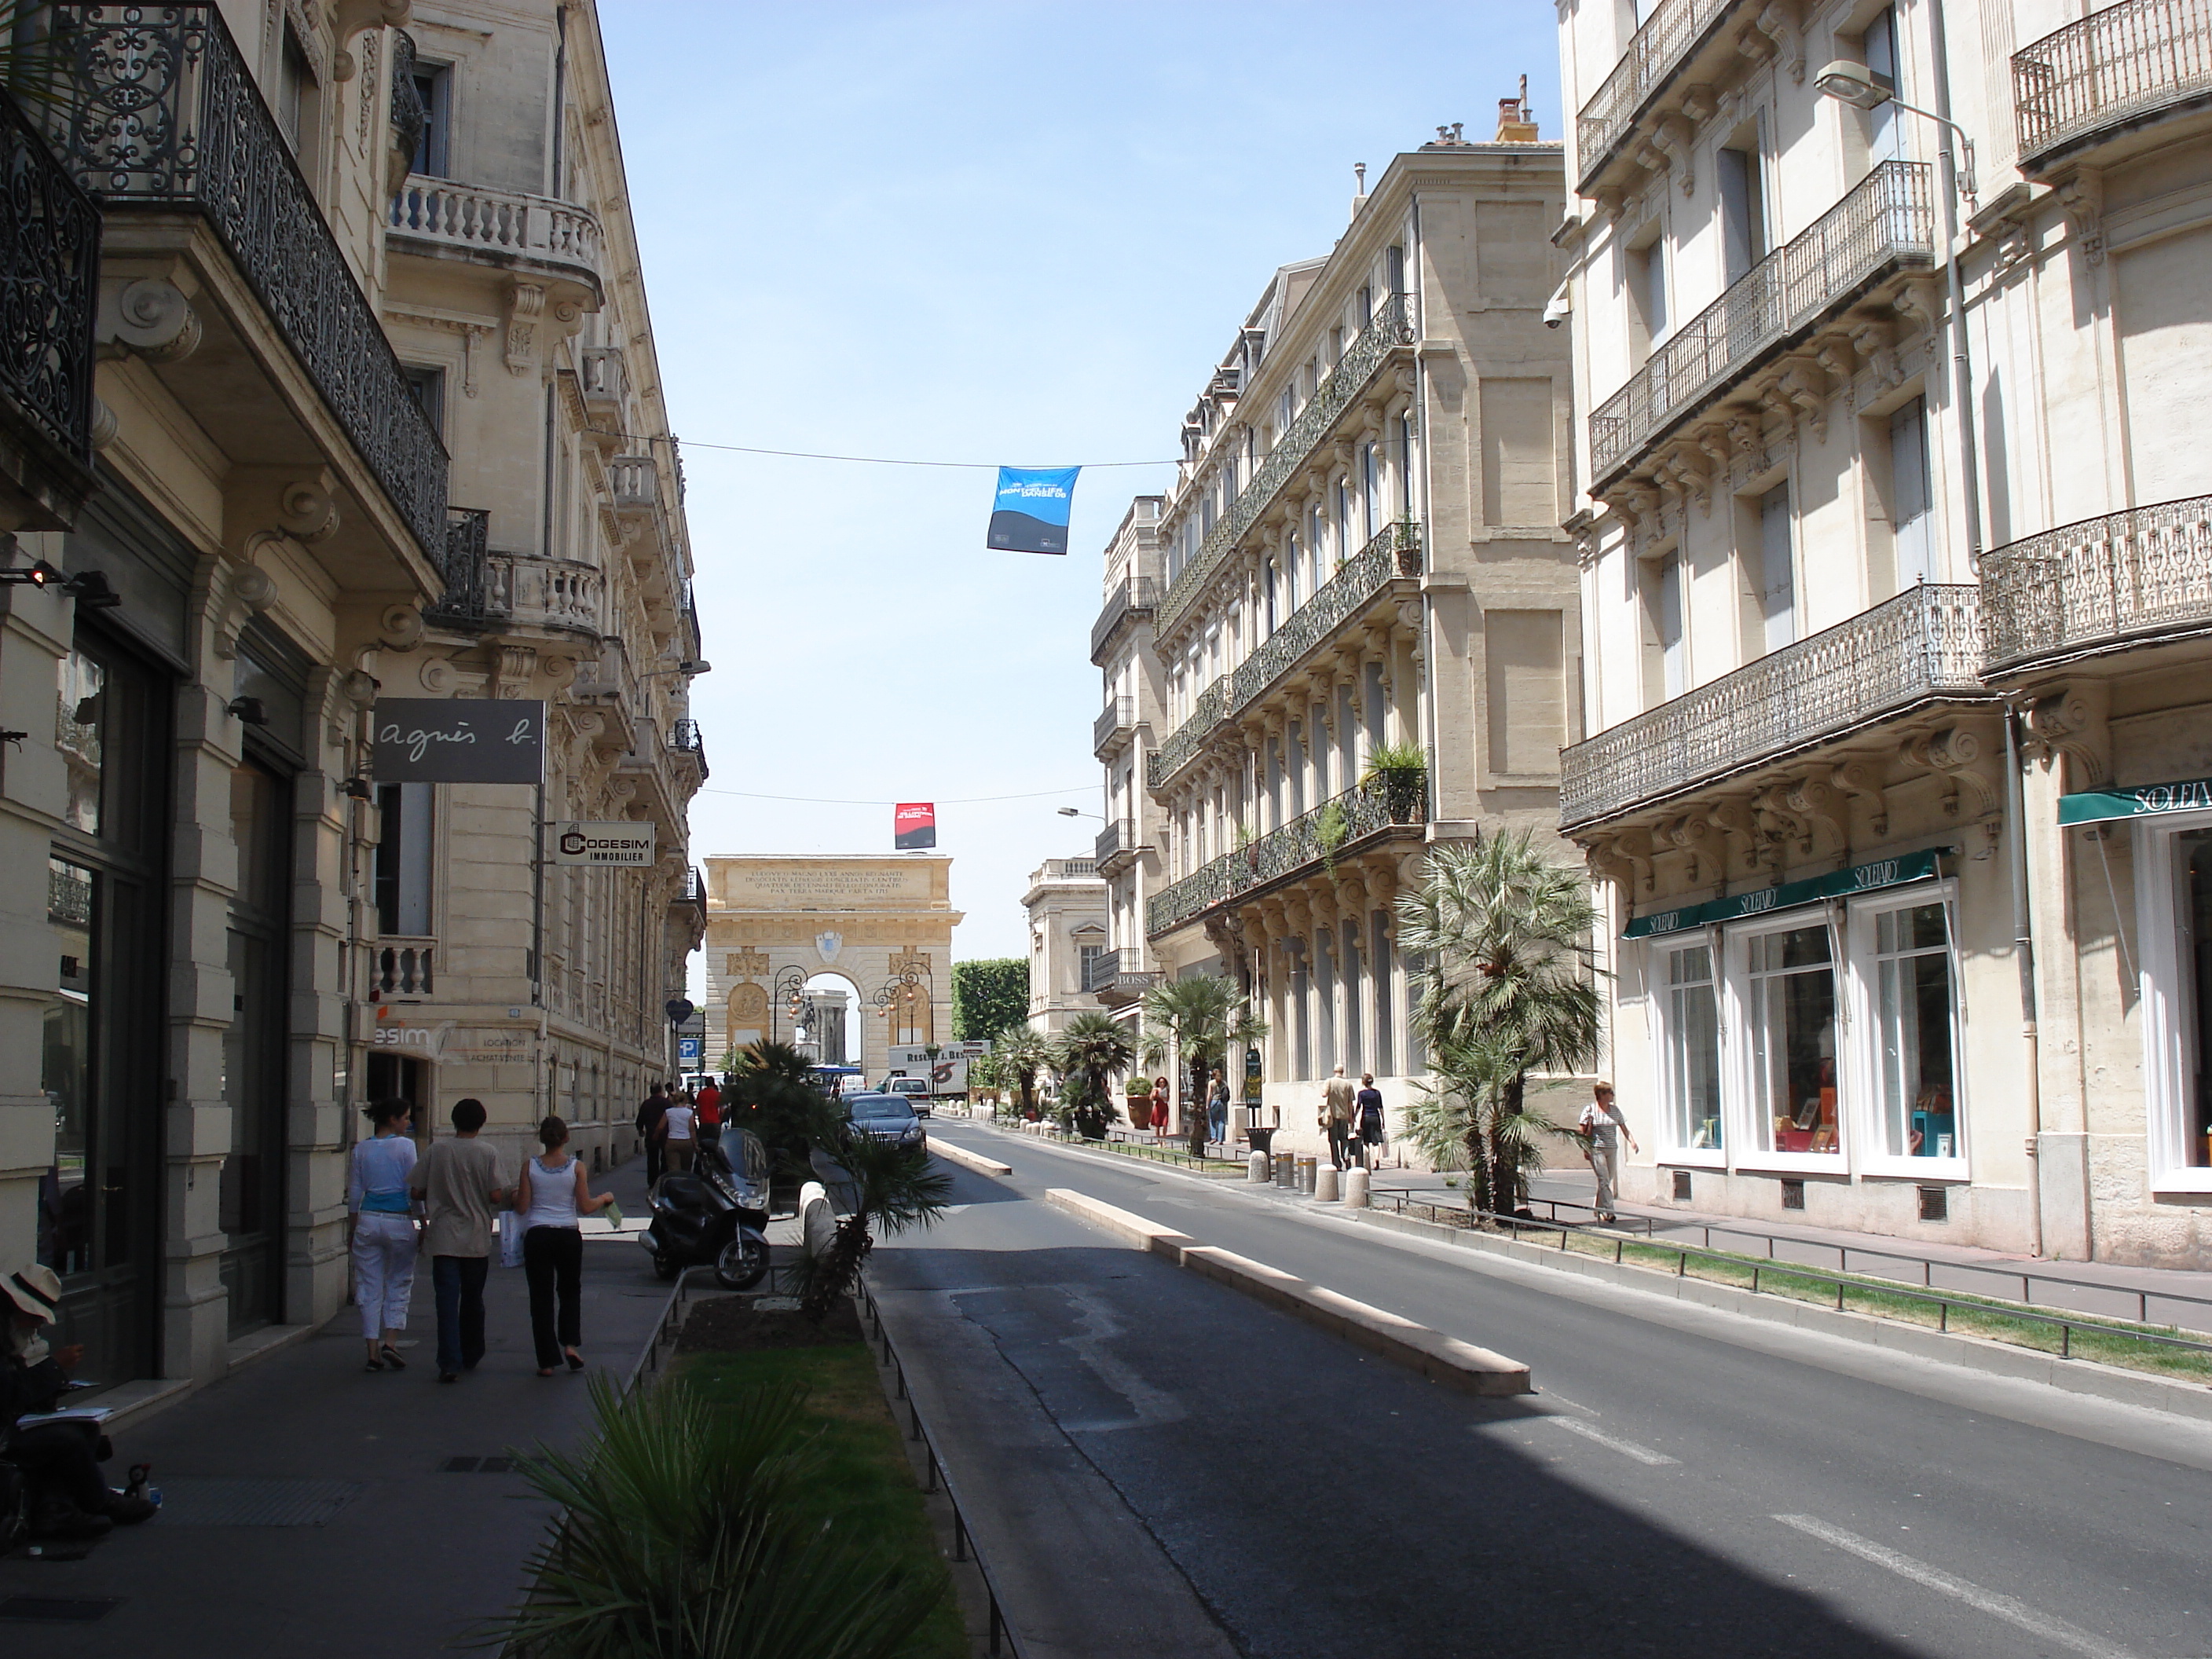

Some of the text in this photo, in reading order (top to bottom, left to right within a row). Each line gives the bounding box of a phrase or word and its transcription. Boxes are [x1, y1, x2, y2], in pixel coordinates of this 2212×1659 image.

[380, 719, 537, 762] agnès b.
[560, 833, 649, 855] COGESIM
[590, 852, 643, 861] IMMOBILIER
[1119, 975, 1148, 985] BOSS
